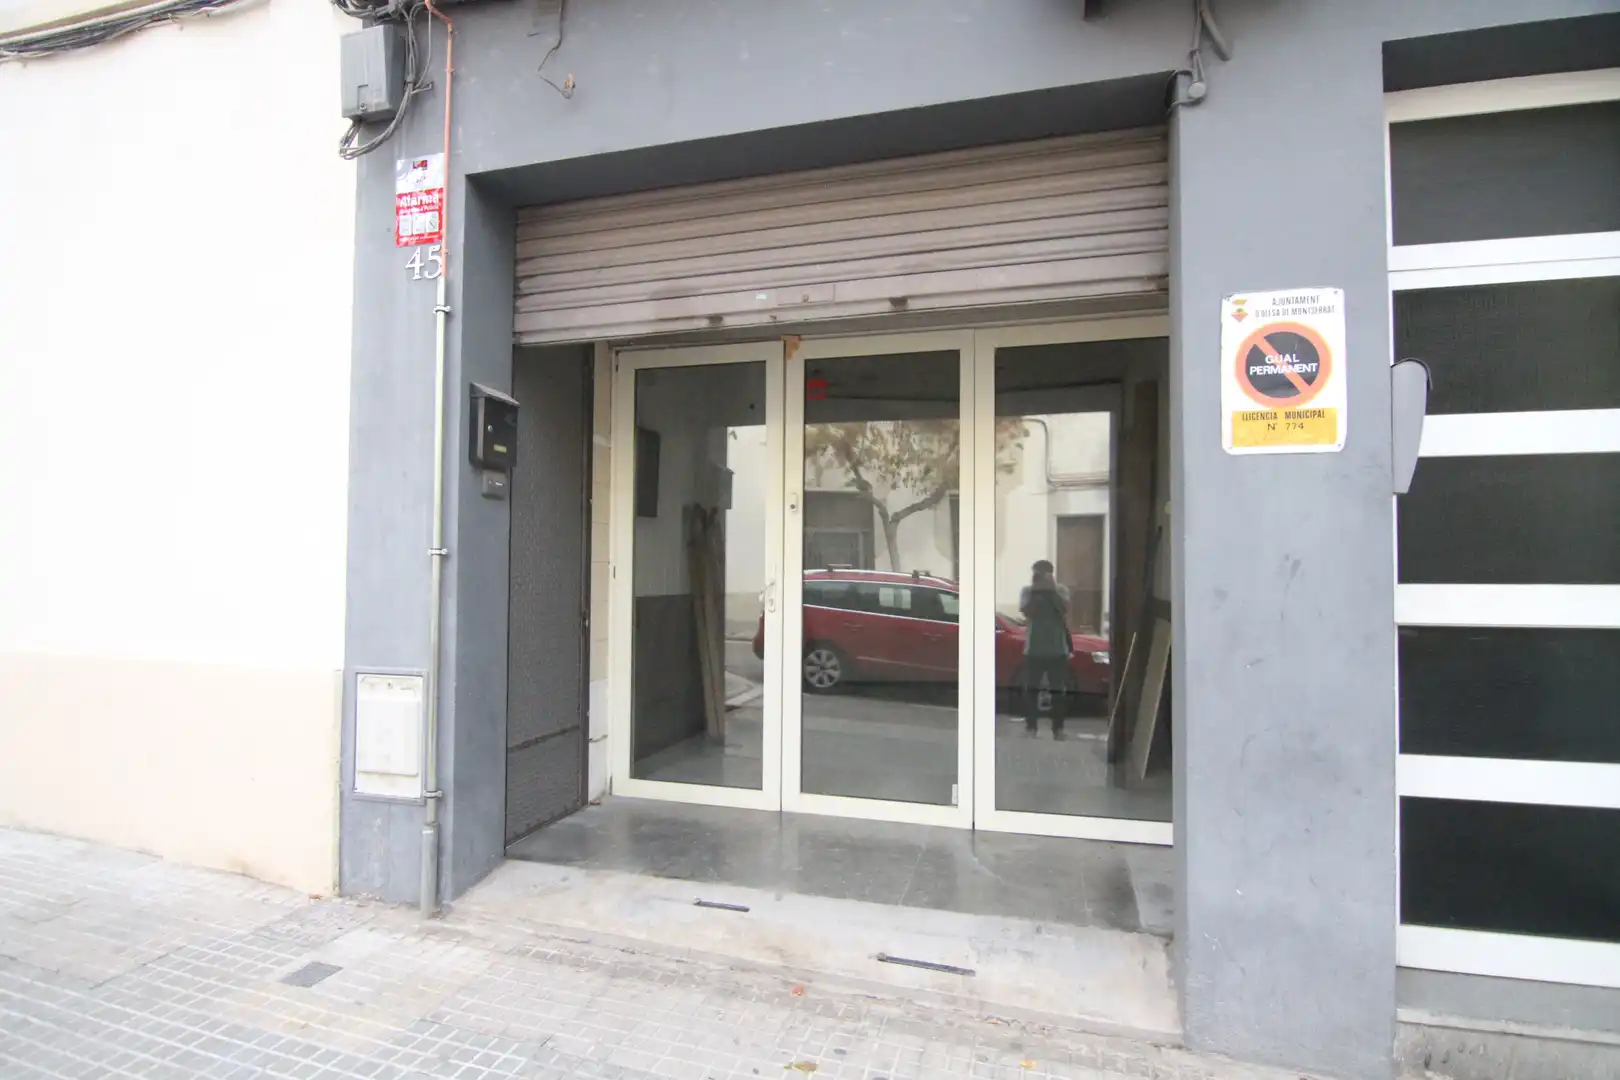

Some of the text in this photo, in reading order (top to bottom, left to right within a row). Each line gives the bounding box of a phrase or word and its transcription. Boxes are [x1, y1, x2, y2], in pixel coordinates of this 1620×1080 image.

[405, 245, 442, 280] 45
[1271, 295, 1320, 306] AJUNTAMENT
[1291, 305, 1335, 316] MONTSERRAT
[1265, 353, 1299, 363] GUAL
[1249, 362, 1319, 376] PERMANENT
[1284, 409, 1325, 420] MUNICIPAL
[1285, 422, 1304, 431] 774
